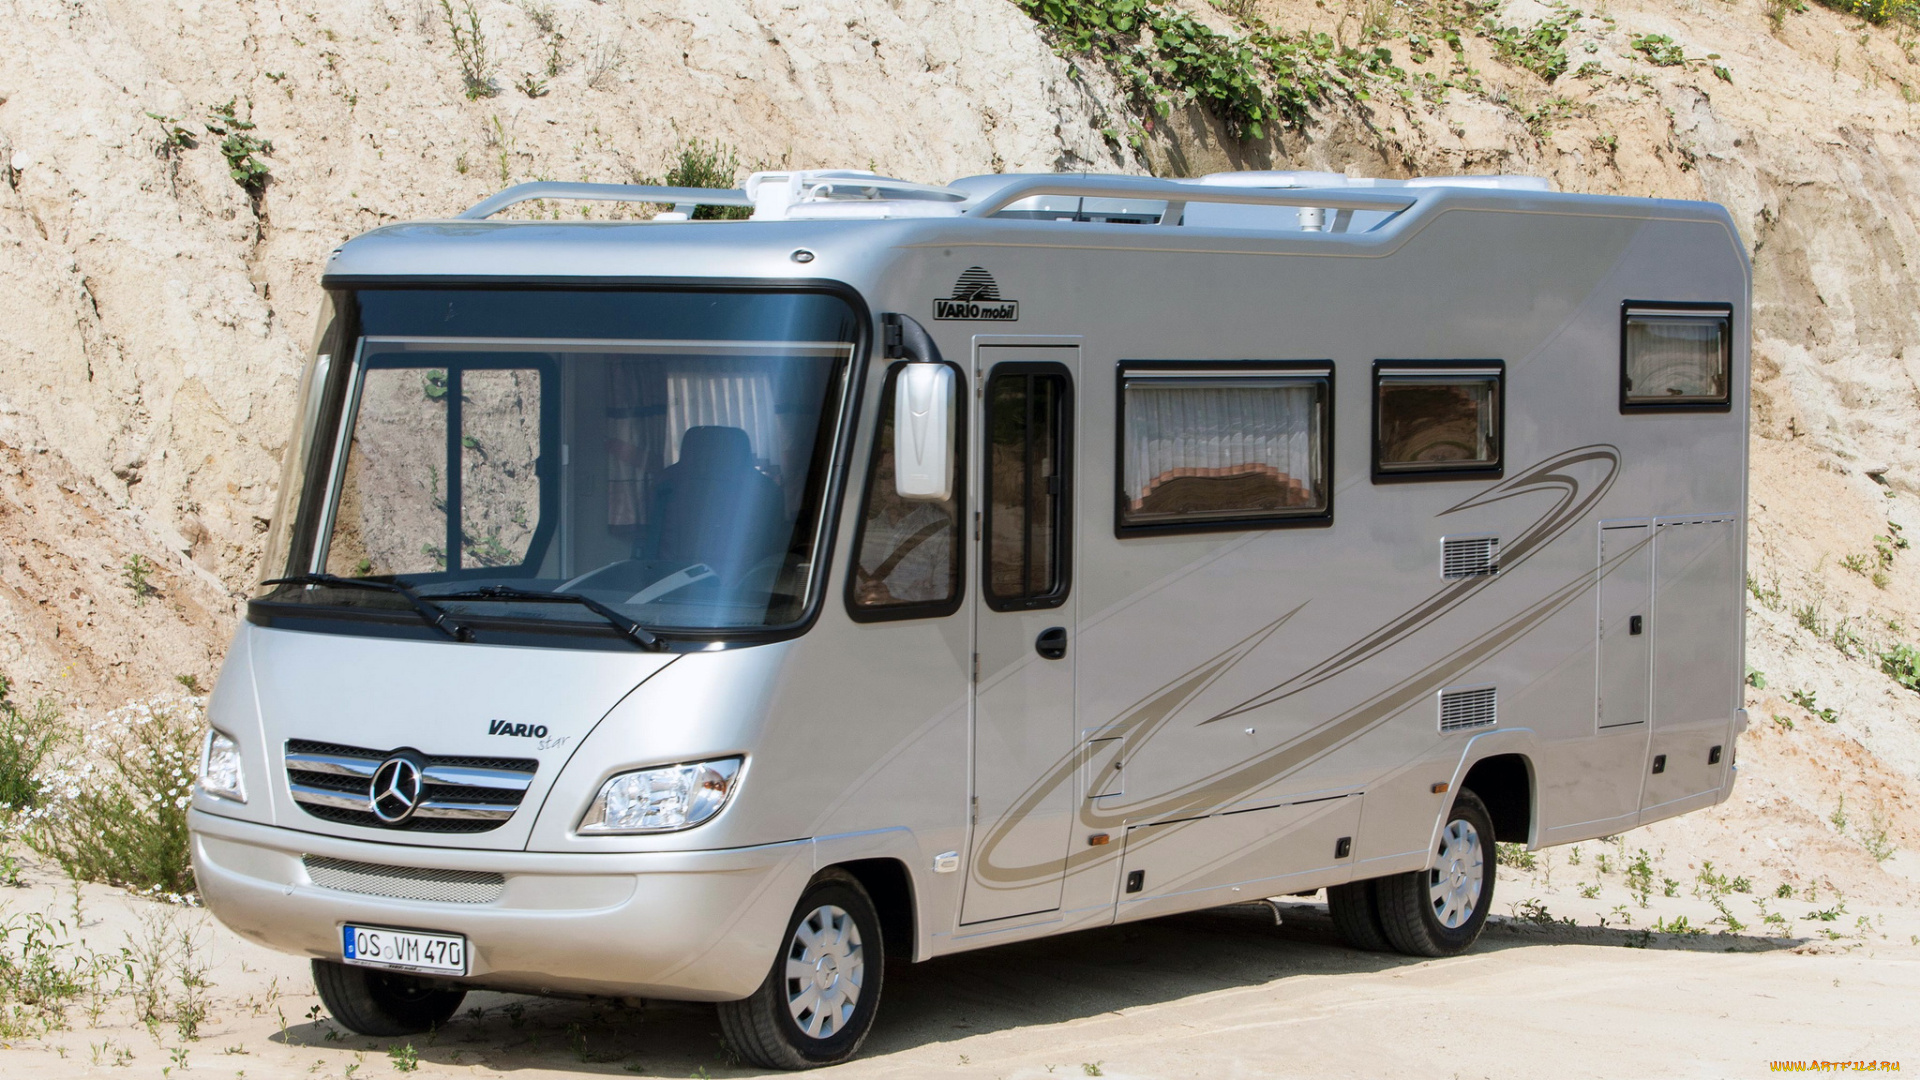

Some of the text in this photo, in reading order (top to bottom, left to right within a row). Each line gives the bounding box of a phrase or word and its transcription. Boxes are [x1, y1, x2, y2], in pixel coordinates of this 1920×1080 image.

[937, 301, 1015, 319] VARIO mobil
[488, 719, 548, 738] VARIO
[537, 735, 571, 750] star
[357, 932, 461, 965] OS VM 470
